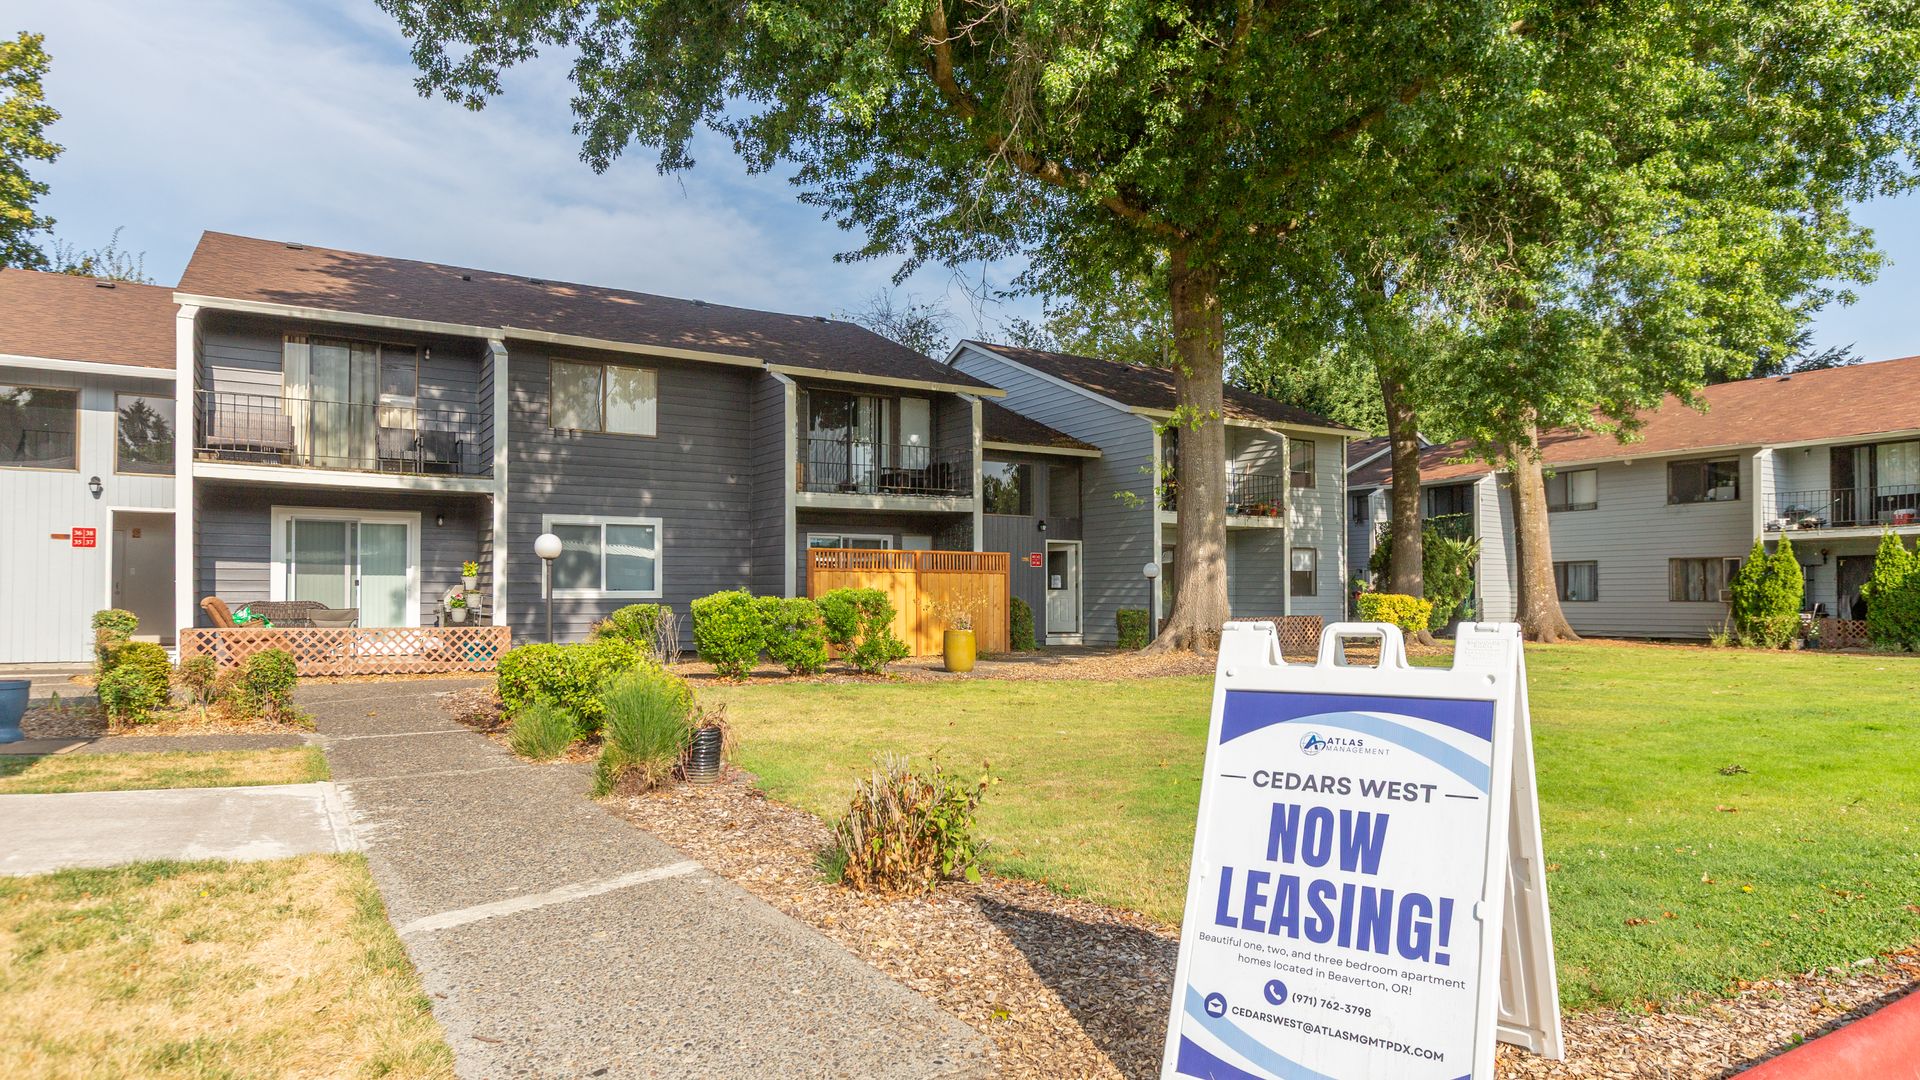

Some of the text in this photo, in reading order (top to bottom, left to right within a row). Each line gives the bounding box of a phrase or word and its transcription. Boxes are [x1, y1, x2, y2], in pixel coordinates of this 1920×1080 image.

[1326, 746, 1390, 756] MANAGEMENT
[1327, 737, 1364, 747] ATLAS
[1252, 770, 1438, 803] CEDARS WEST
[1266, 802, 1390, 876] NOW
[1214, 866, 1455, 966] LEASING!
[1199, 931, 1466, 990] Beautiful one, two, and three bedroom apartment
[1238, 953, 1413, 996] homes located in Beaverton, OR!
[1292, 992, 1372, 1018] (971) 762-3798
[1231, 1005, 1445, 1063] CEDARSWEST@ATLASMGMTPDX.COM
